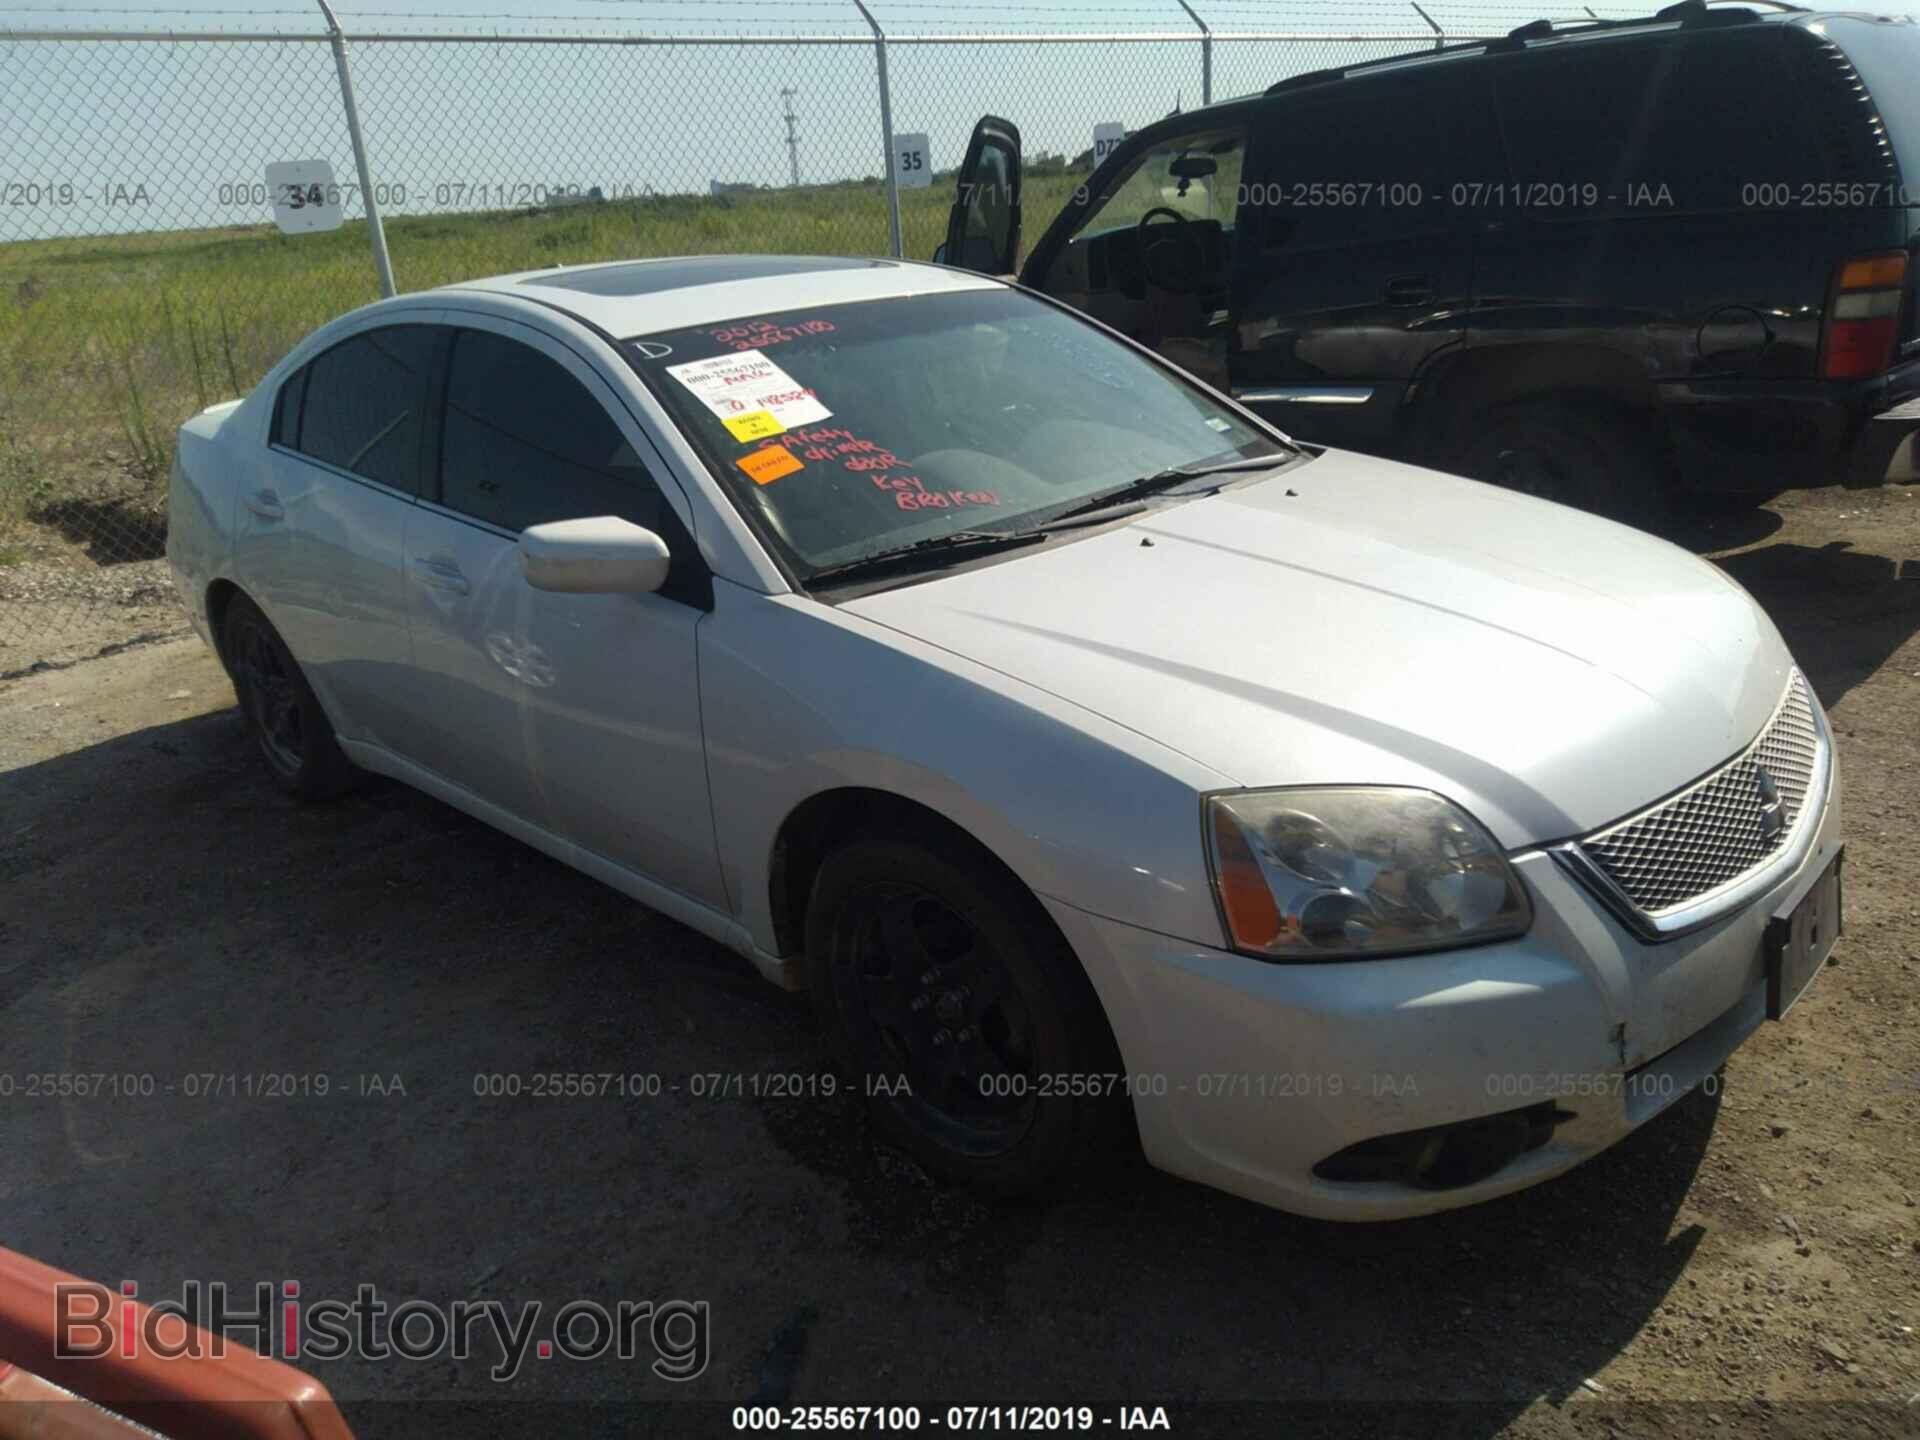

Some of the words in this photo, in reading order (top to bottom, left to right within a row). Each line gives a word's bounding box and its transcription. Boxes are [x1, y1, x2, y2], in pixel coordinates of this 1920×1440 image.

[902, 151, 922, 171] 35
[286, 183, 325, 210] 34
[631, 341, 673, 360] D
